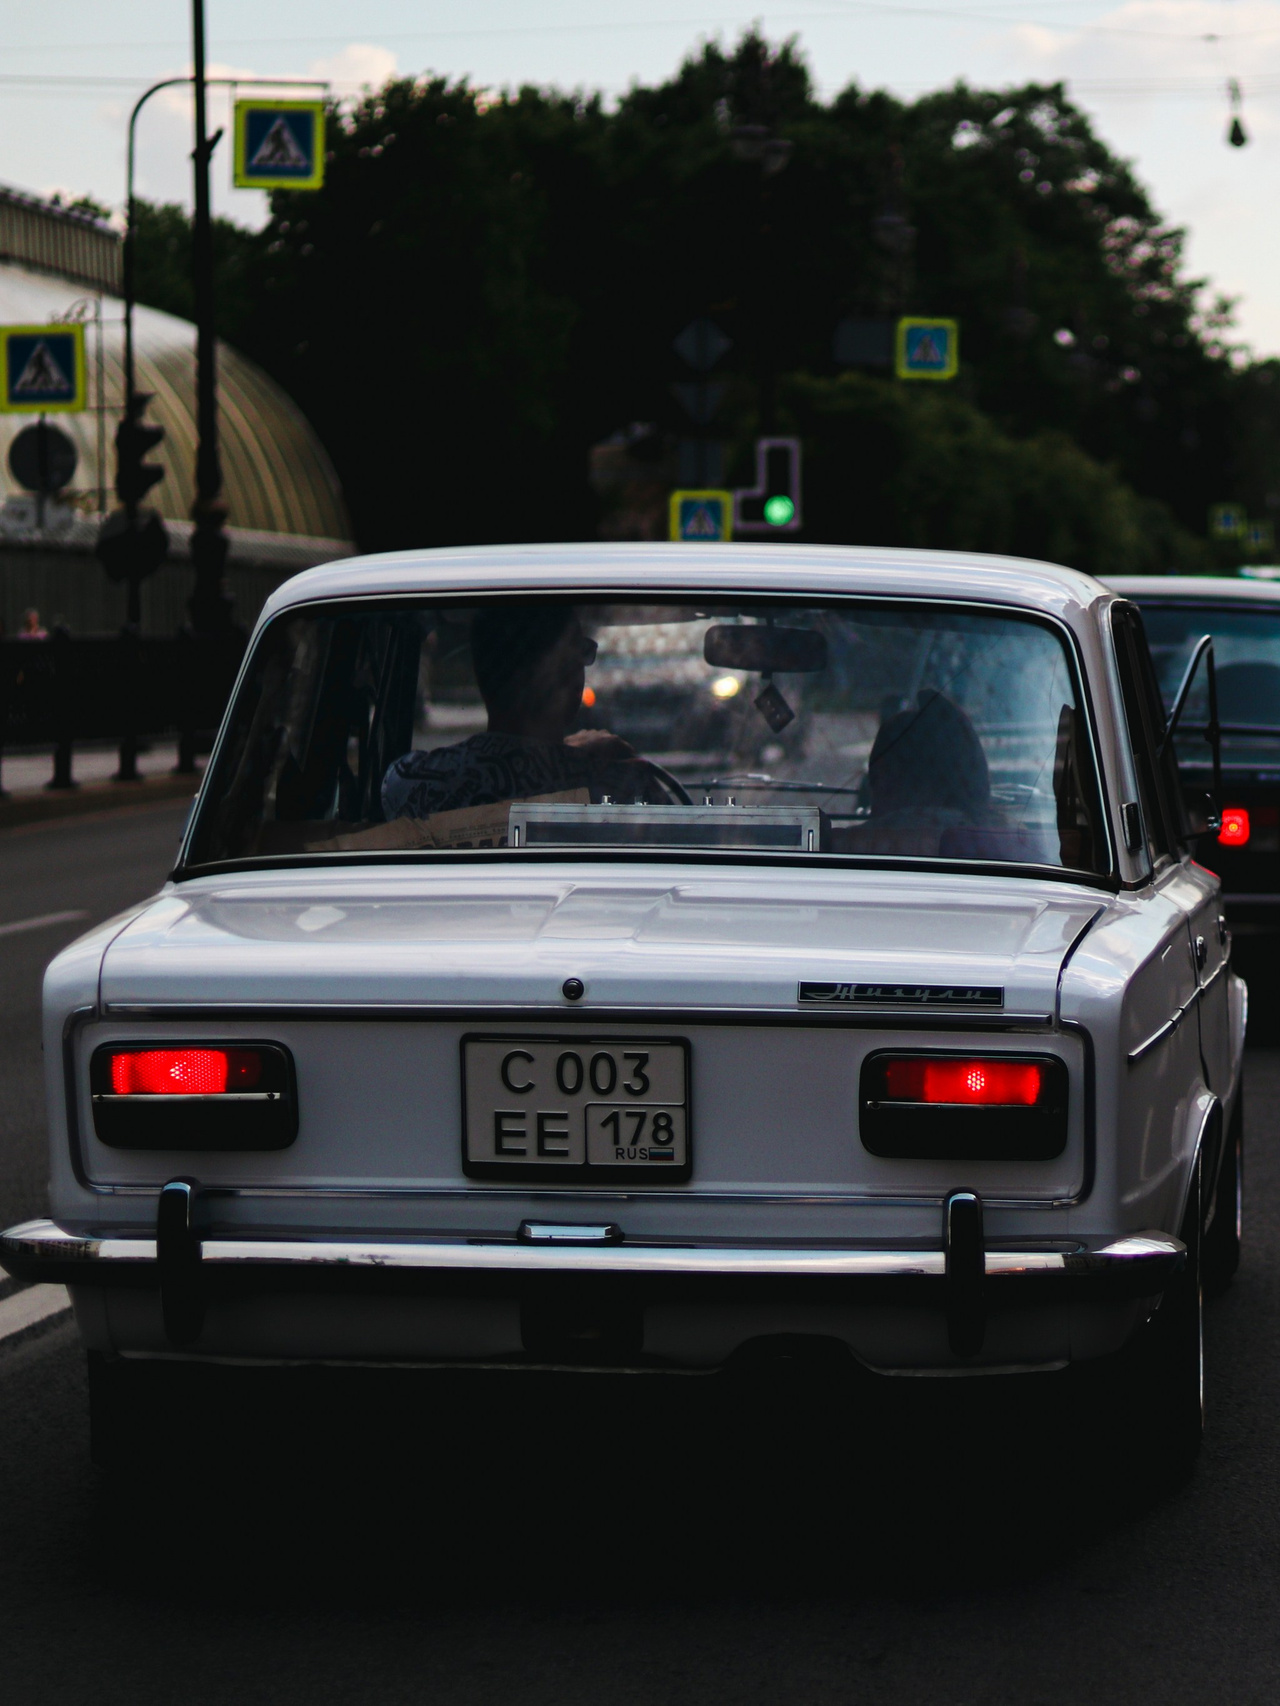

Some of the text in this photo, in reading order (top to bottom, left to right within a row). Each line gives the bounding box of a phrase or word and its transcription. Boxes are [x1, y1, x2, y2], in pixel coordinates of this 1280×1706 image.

[804, 983, 999, 1002] Жигули
[556, 1051, 650, 1096] 003
[600, 1110, 674, 1146] 178
[616, 1147, 648, 1160] RUS
